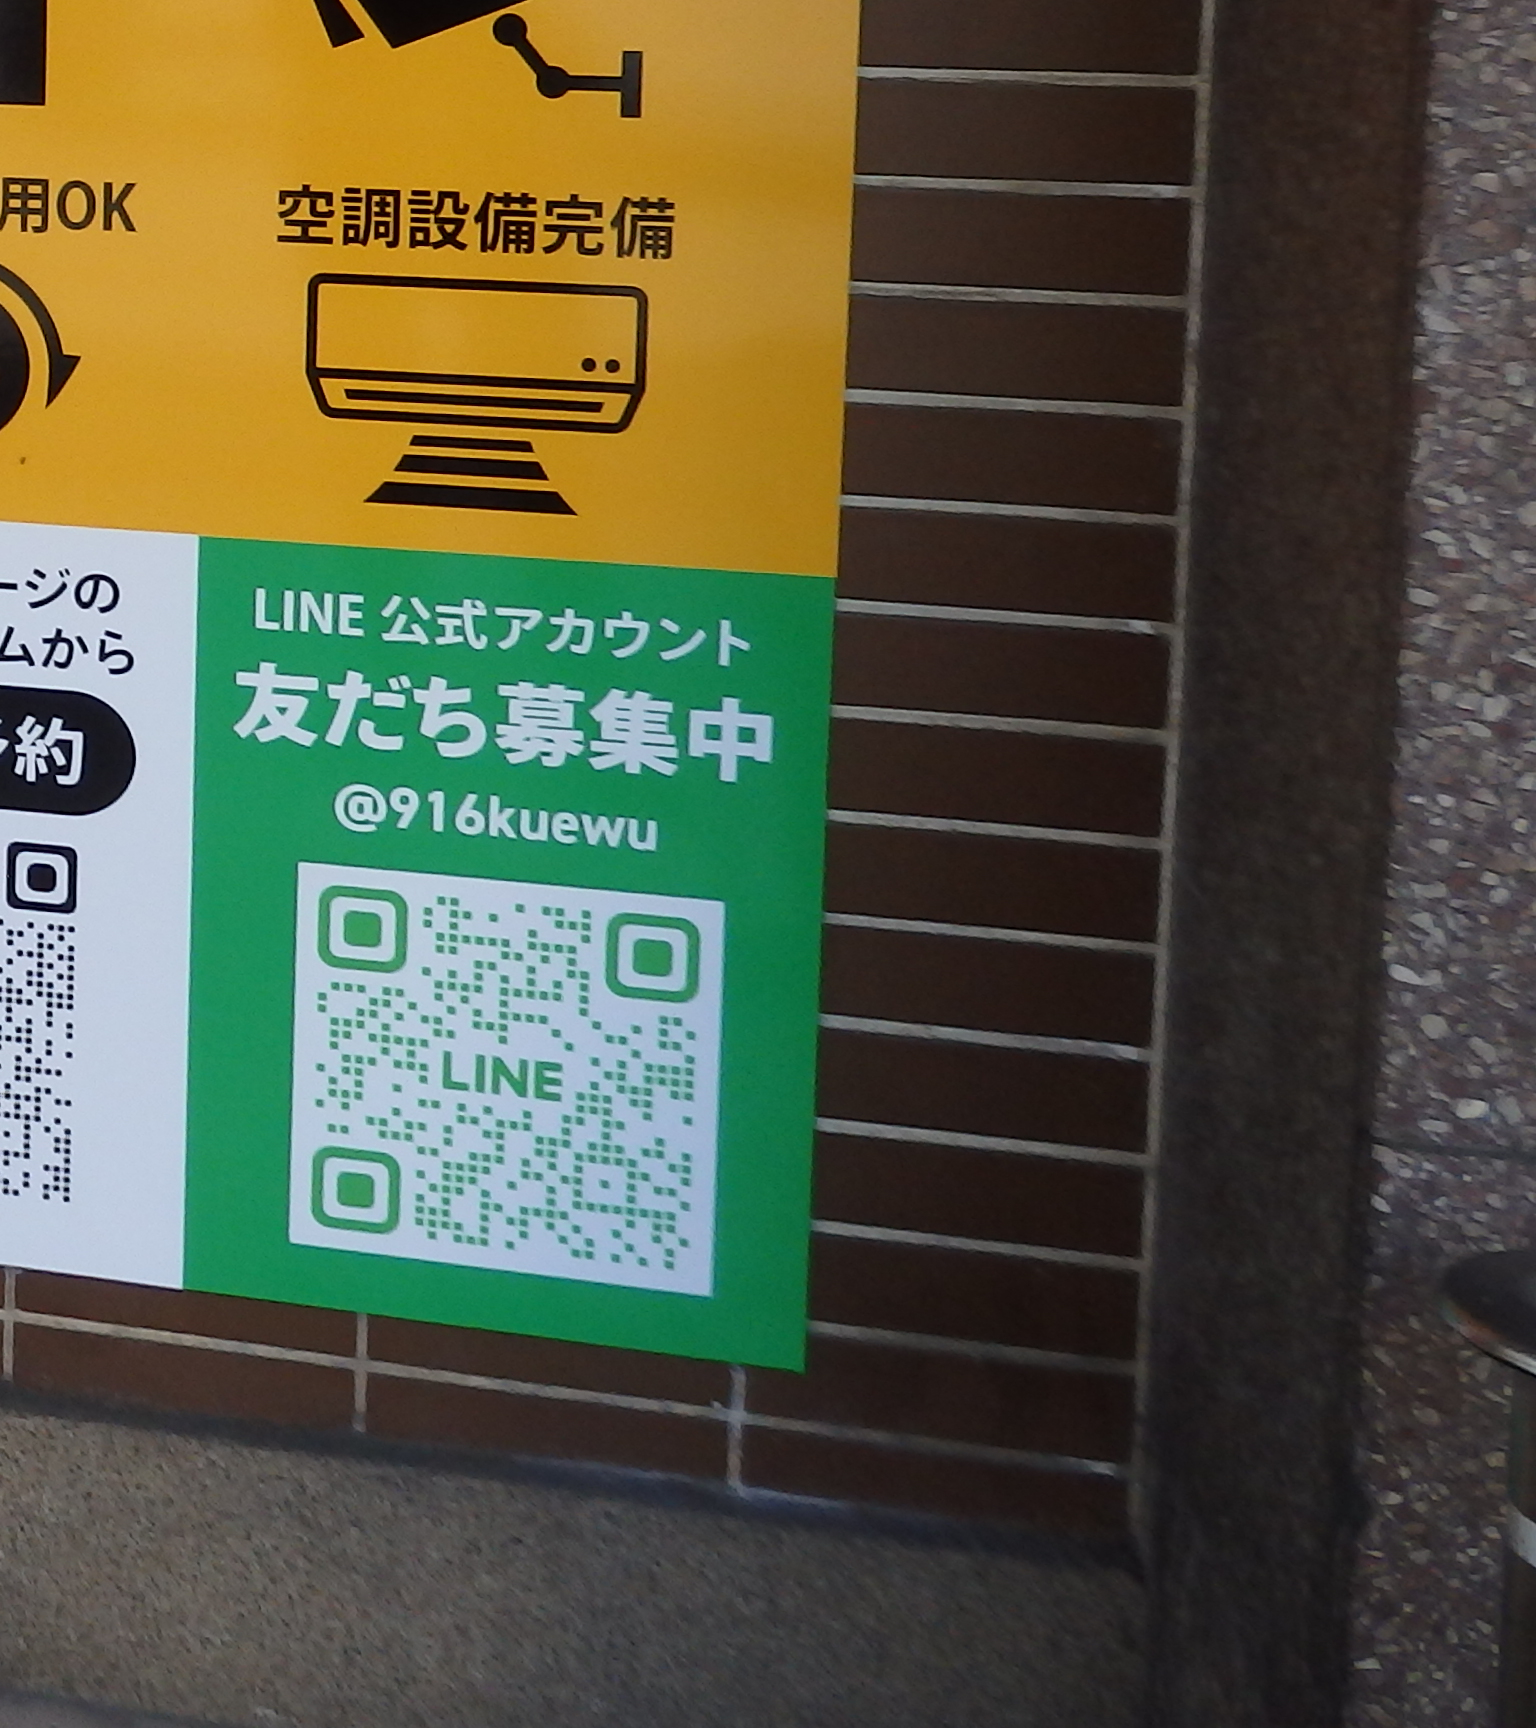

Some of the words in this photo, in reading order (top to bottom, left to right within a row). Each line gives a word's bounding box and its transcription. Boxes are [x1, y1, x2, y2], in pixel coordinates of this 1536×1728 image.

[278, 184, 675, 259] 空調設備完備
[256, 588, 364, 636] LINE
[381, 596, 749, 666] 公式アカウント
[234, 660, 772, 787] 友だち募集中
[335, 784, 657, 850] @916kuewu
[438, 1043, 567, 1107] LINE
